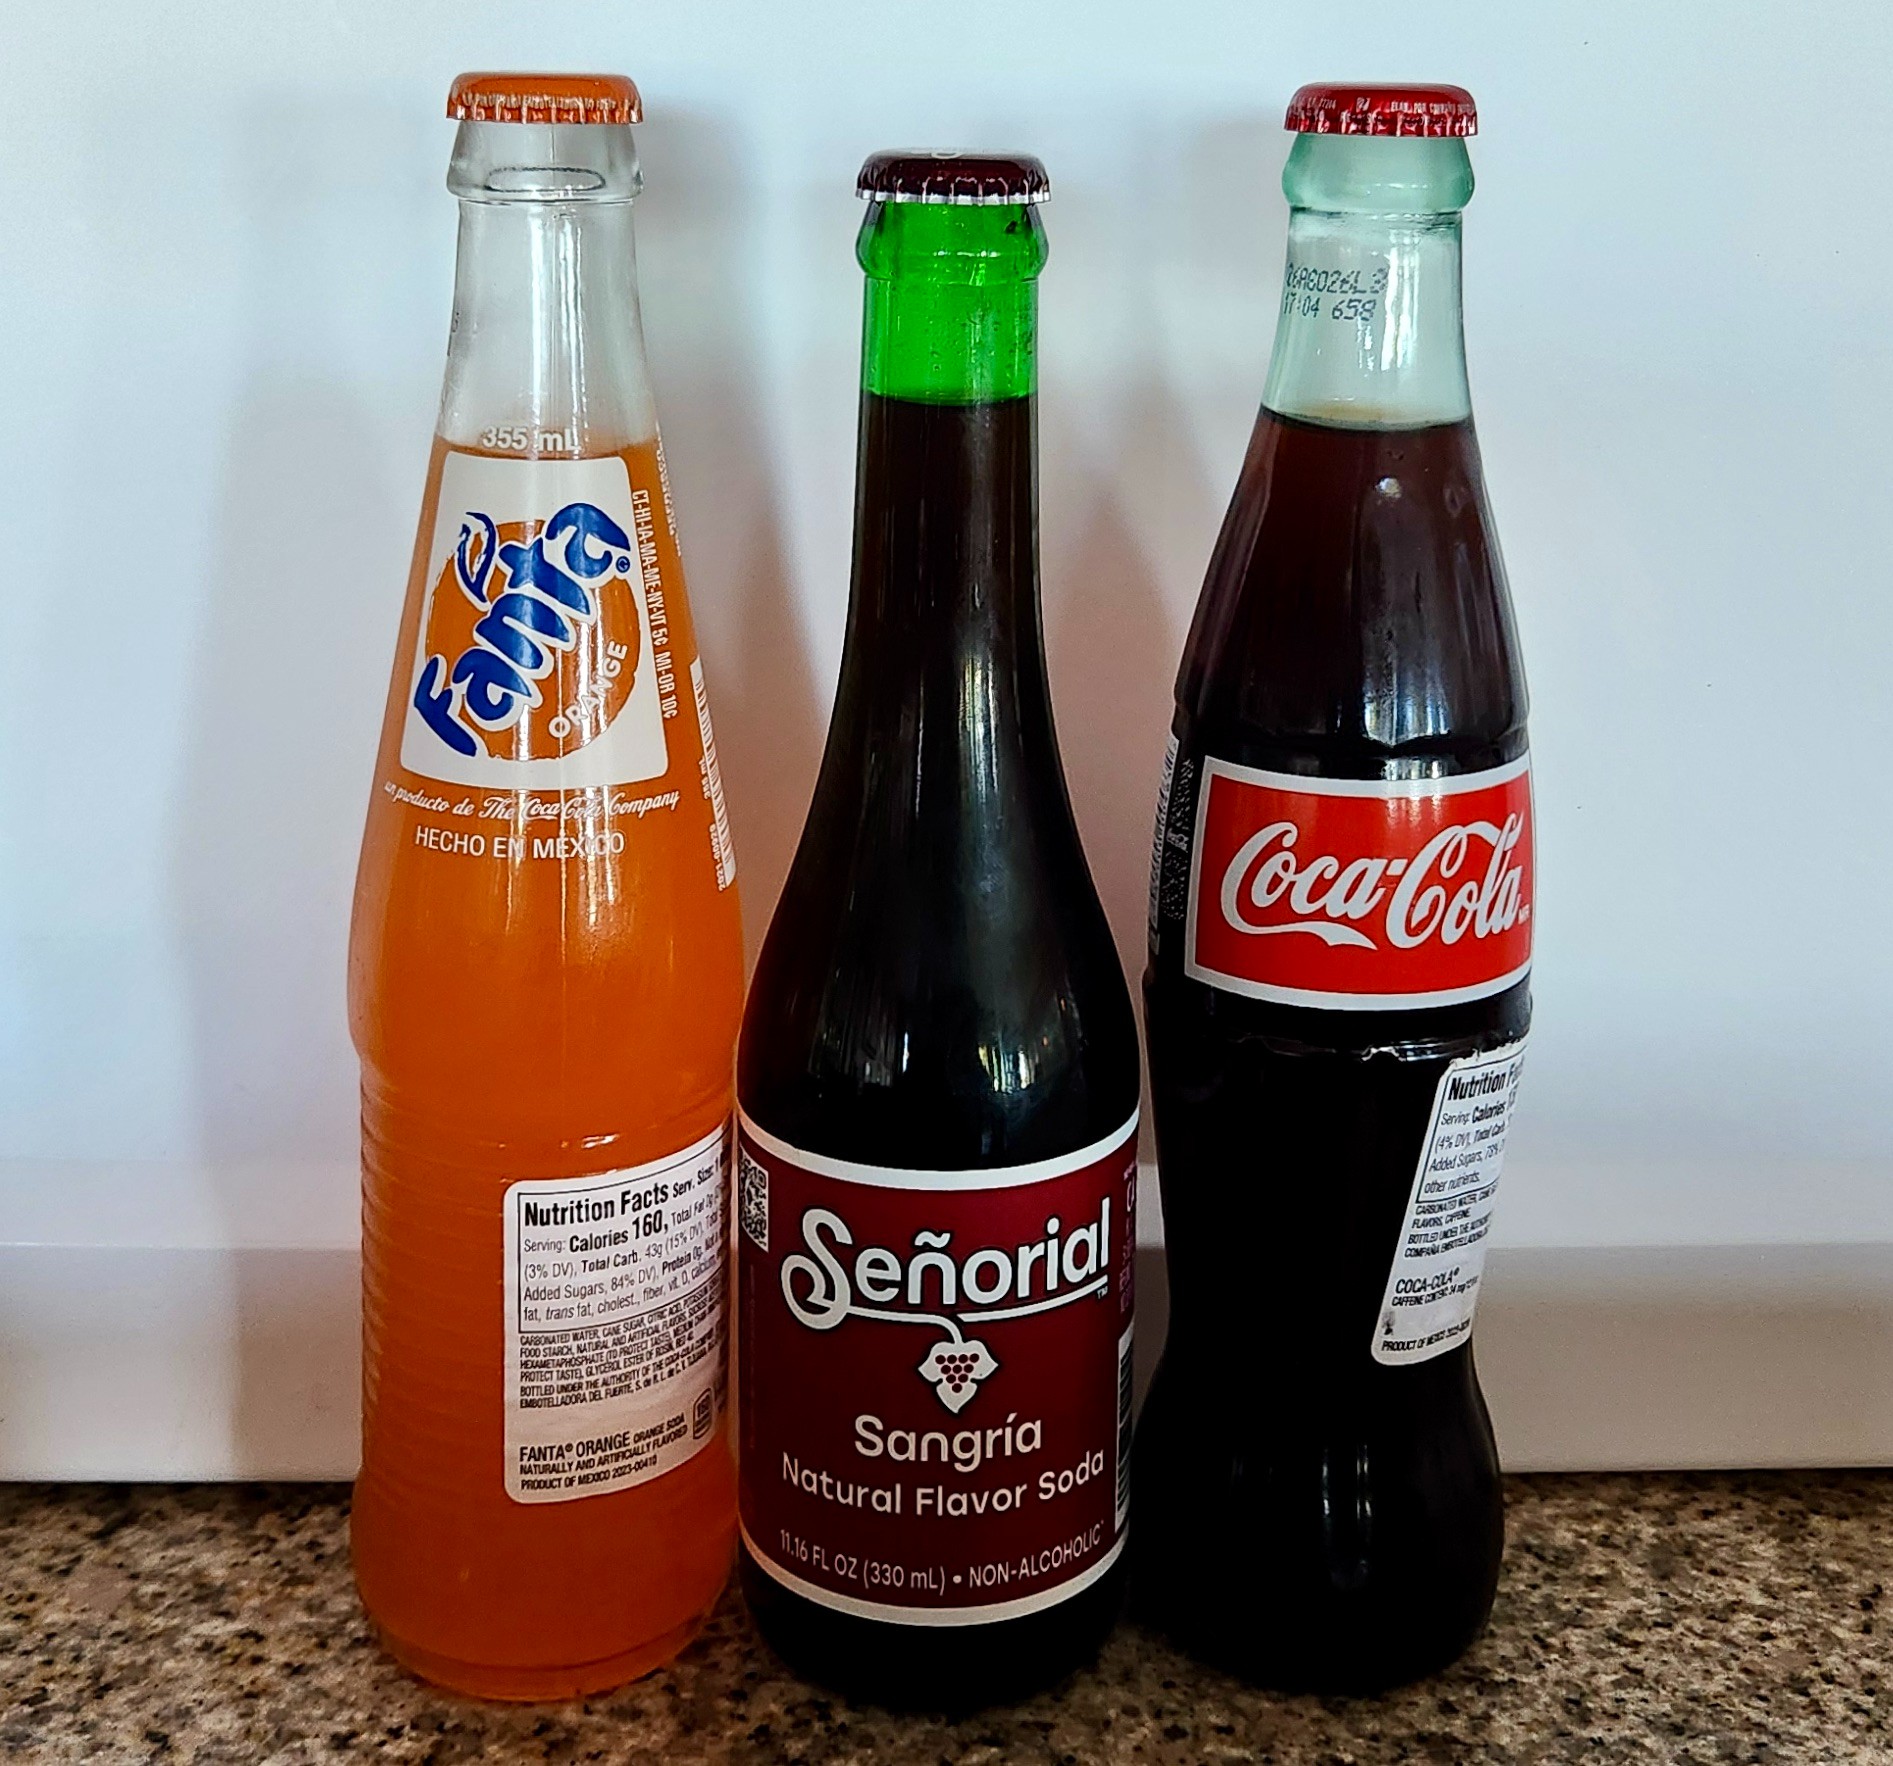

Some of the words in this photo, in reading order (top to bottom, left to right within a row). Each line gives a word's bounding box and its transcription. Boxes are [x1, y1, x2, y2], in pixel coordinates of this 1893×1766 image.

[1332, 298, 1377, 321] 658
[482, 426, 527, 450] 355
[539, 428, 581, 451] mL
[414, 503, 630, 757] Fanta
[548, 641, 628, 738] ORANGE
[655, 651, 675, 694] MI-OR
[394, 785, 450, 812] producto
[452, 798, 475, 816] de
[478, 796, 515, 820] The
[607, 790, 680, 818] Company
[415, 825, 485, 857] HECHO
[493, 837, 525, 859] EN
[533, 832, 625, 859] MEXICO
[1221, 812, 1524, 950] Coca-Cola
[1447, 1070, 1506, 1101] Nutrition
[1472, 1101, 1506, 1124] Calories
[1429, 1155, 1457, 1172] Added
[525, 1198, 615, 1227] Nutrition
[621, 1183, 669, 1215] Facts
[673, 1178, 695, 1198] Serv.
[524, 1239, 566, 1254] Serving:
[569, 1230, 629, 1253] Calories
[632, 1209, 668, 1240] 160,
[671, 1205, 692, 1227] Total
[524, 1264, 549, 1282] (3%
[581, 1256, 610, 1273] Total
[613, 1249, 641, 1268] Carb.
[645, 1243, 663, 1259] 43g
[665, 1231, 688, 1255] (15%
[781, 1197, 1111, 1330] Señorial
[524, 1286, 561, 1301] Added
[564, 1281, 608, 1300] Sugars,
[611, 1272, 635, 1292] 84%
[662, 1251, 692, 1276] Protein
[524, 1307, 541, 1323] fat,
[546, 1306, 574, 1320] trans
[577, 1302, 595, 1317] fat,
[643, 1285, 666, 1300] fiber,
[520, 1333, 570, 1346] CARBONATED
[602, 1325, 622, 1337] CANE
[520, 1347, 541, 1358] FOOD
[576, 1339, 609, 1354] NATURAL
[611, 1335, 626, 1347] AND
[606, 1349, 618, 1363] (TO
[619, 1340, 649, 1357] PROTECT
[520, 1370, 553, 1383] PROTECT
[585, 1359, 622, 1377] GLYCEROL
[623, 1353, 645, 1368] ESTER
[646, 1349, 655, 1362] OF
[520, 1385, 555, 1397] BOTTLED
[557, 1381, 584, 1394] UNDER
[585, 1379, 600, 1391] THE
[601, 1366, 641, 1388] AUTHORITY
[641, 1364, 652, 1377] OF
[652, 1359, 665, 1374] THE
[520, 1392, 587, 1409] EMBOTELLADORA
[589, 1389, 604, 1402] DEL
[520, 1460, 573, 1475] NATURALLY
[576, 1458, 595, 1472] AND
[597, 1443, 651, 1467] ARTIFICIALLY
[652, 1424, 688, 1450] FLAVORED
[576, 1431, 631, 1458] ORANGE
[633, 1423, 664, 1443] ORANGE
[666, 1412, 685, 1430] SODA
[854, 1413, 1042, 1473] Sangría
[521, 1477, 562, 1490] PRODUCT
[565, 1475, 576, 1488] OF
[578, 1469, 610, 1485] MEXICO
[783, 1452, 901, 1515] Natural
[915, 1484, 1027, 1516] Flavor
[1038, 1449, 1104, 1500] Soda
[780, 1529, 808, 1562] 11.16
[813, 1545, 830, 1571] FL
[834, 1554, 858, 1579] OZ
[863, 1559, 904, 1589] (330
[910, 1565, 945, 1596] mL)
